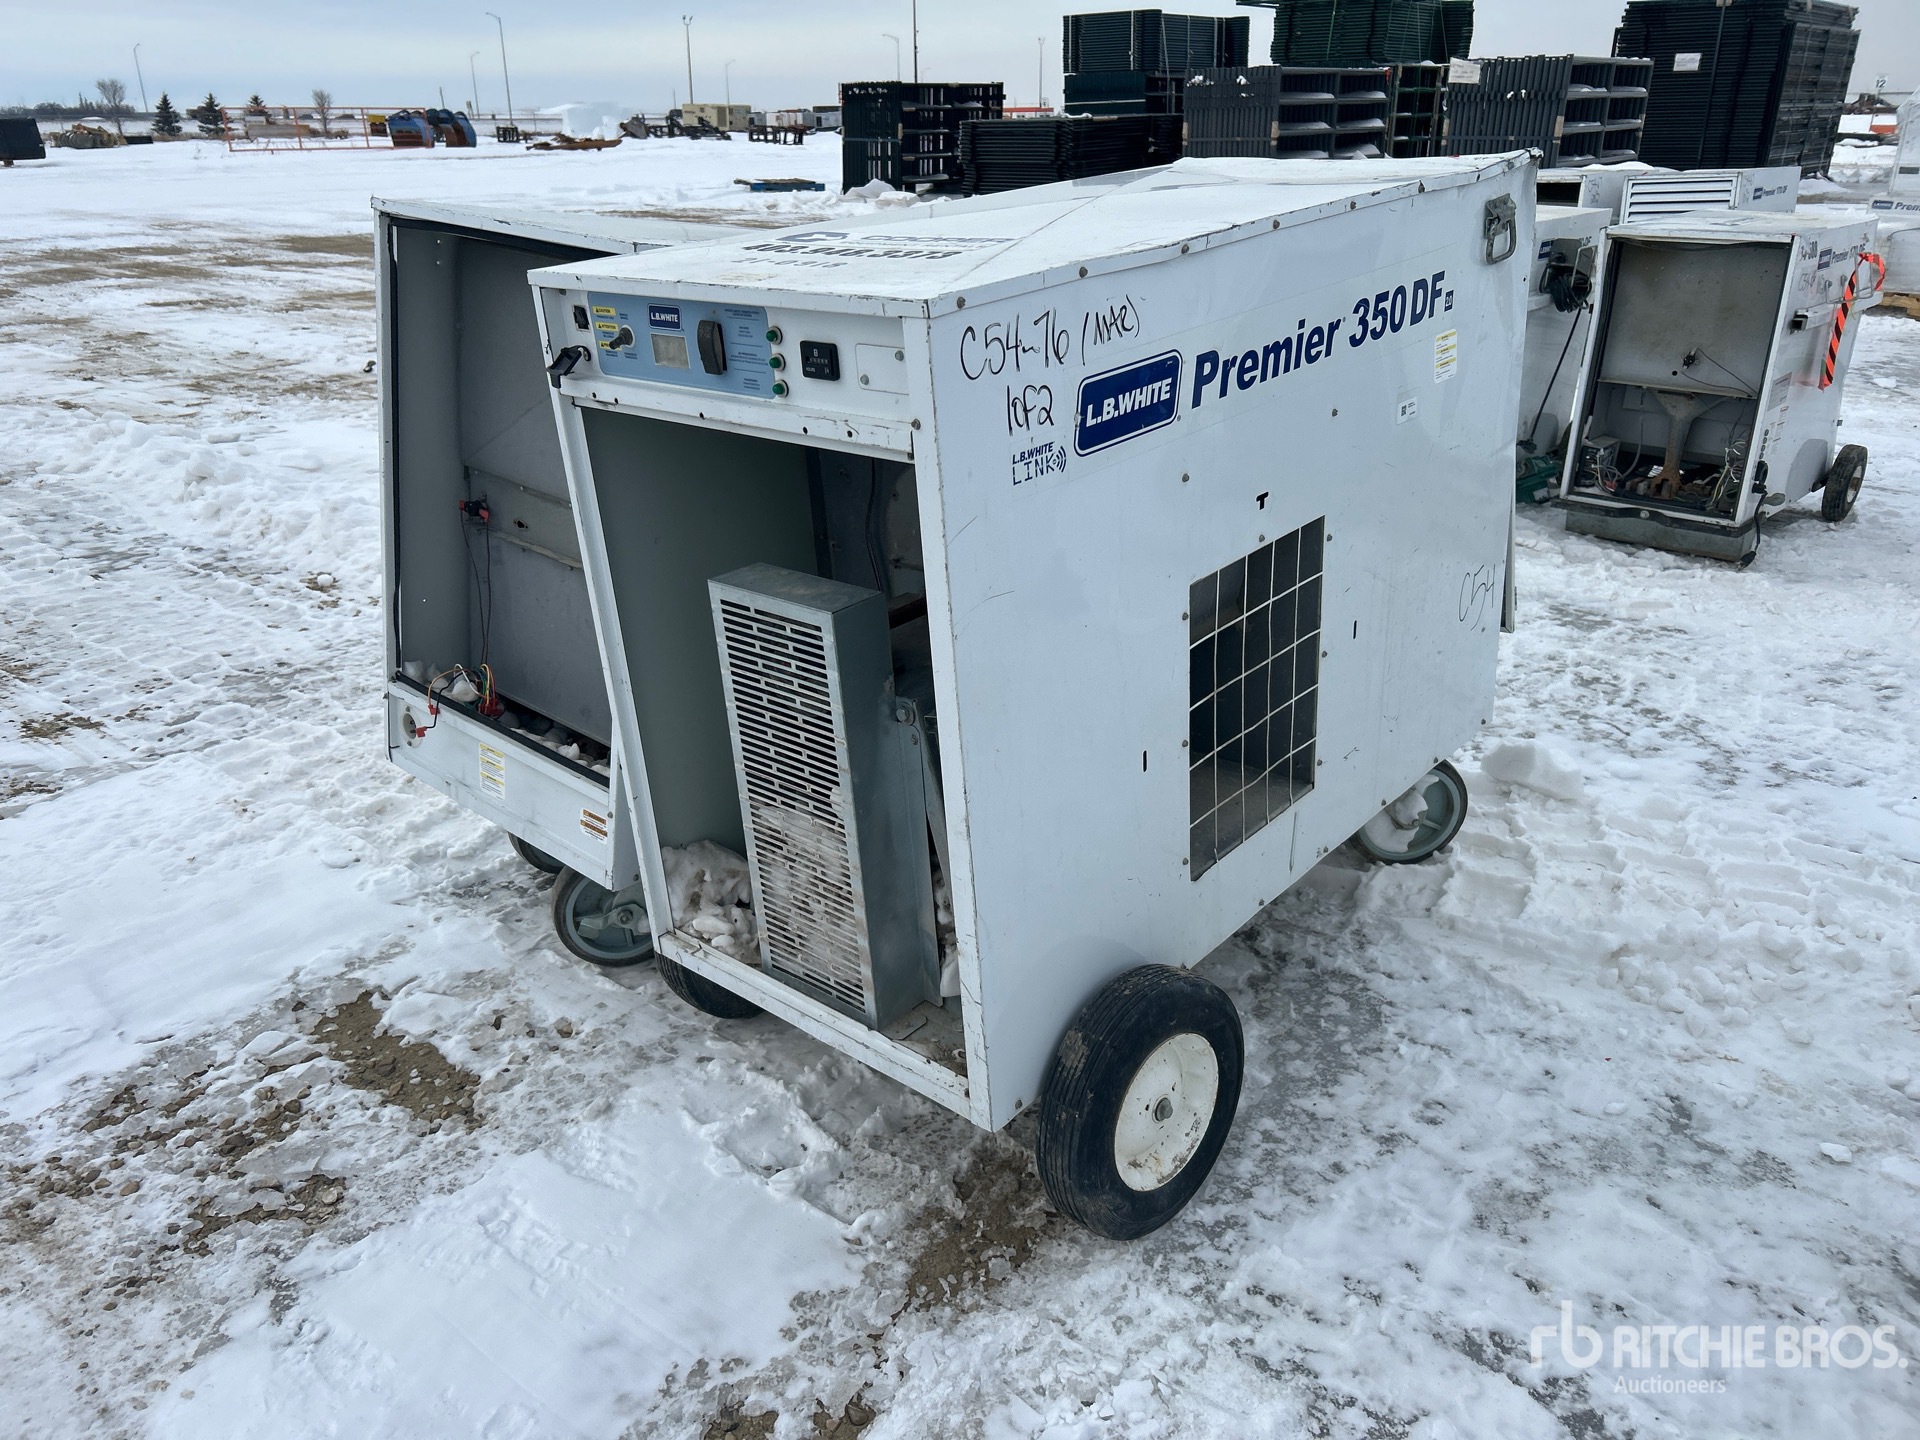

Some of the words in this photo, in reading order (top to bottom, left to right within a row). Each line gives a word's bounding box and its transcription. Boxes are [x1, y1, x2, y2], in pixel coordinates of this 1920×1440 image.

[861, 235, 1016, 243] COOPER
[650, 312, 678, 322] L.B.WHITE
[1191, 315, 1342, 410] Premier
[1086, 378, 1172, 428] L.B.WHITE
[1012, 441, 1055, 465] L.B.WHITE
[1012, 453, 1055, 486] LINK
[1458, 564, 1496, 632] C54
